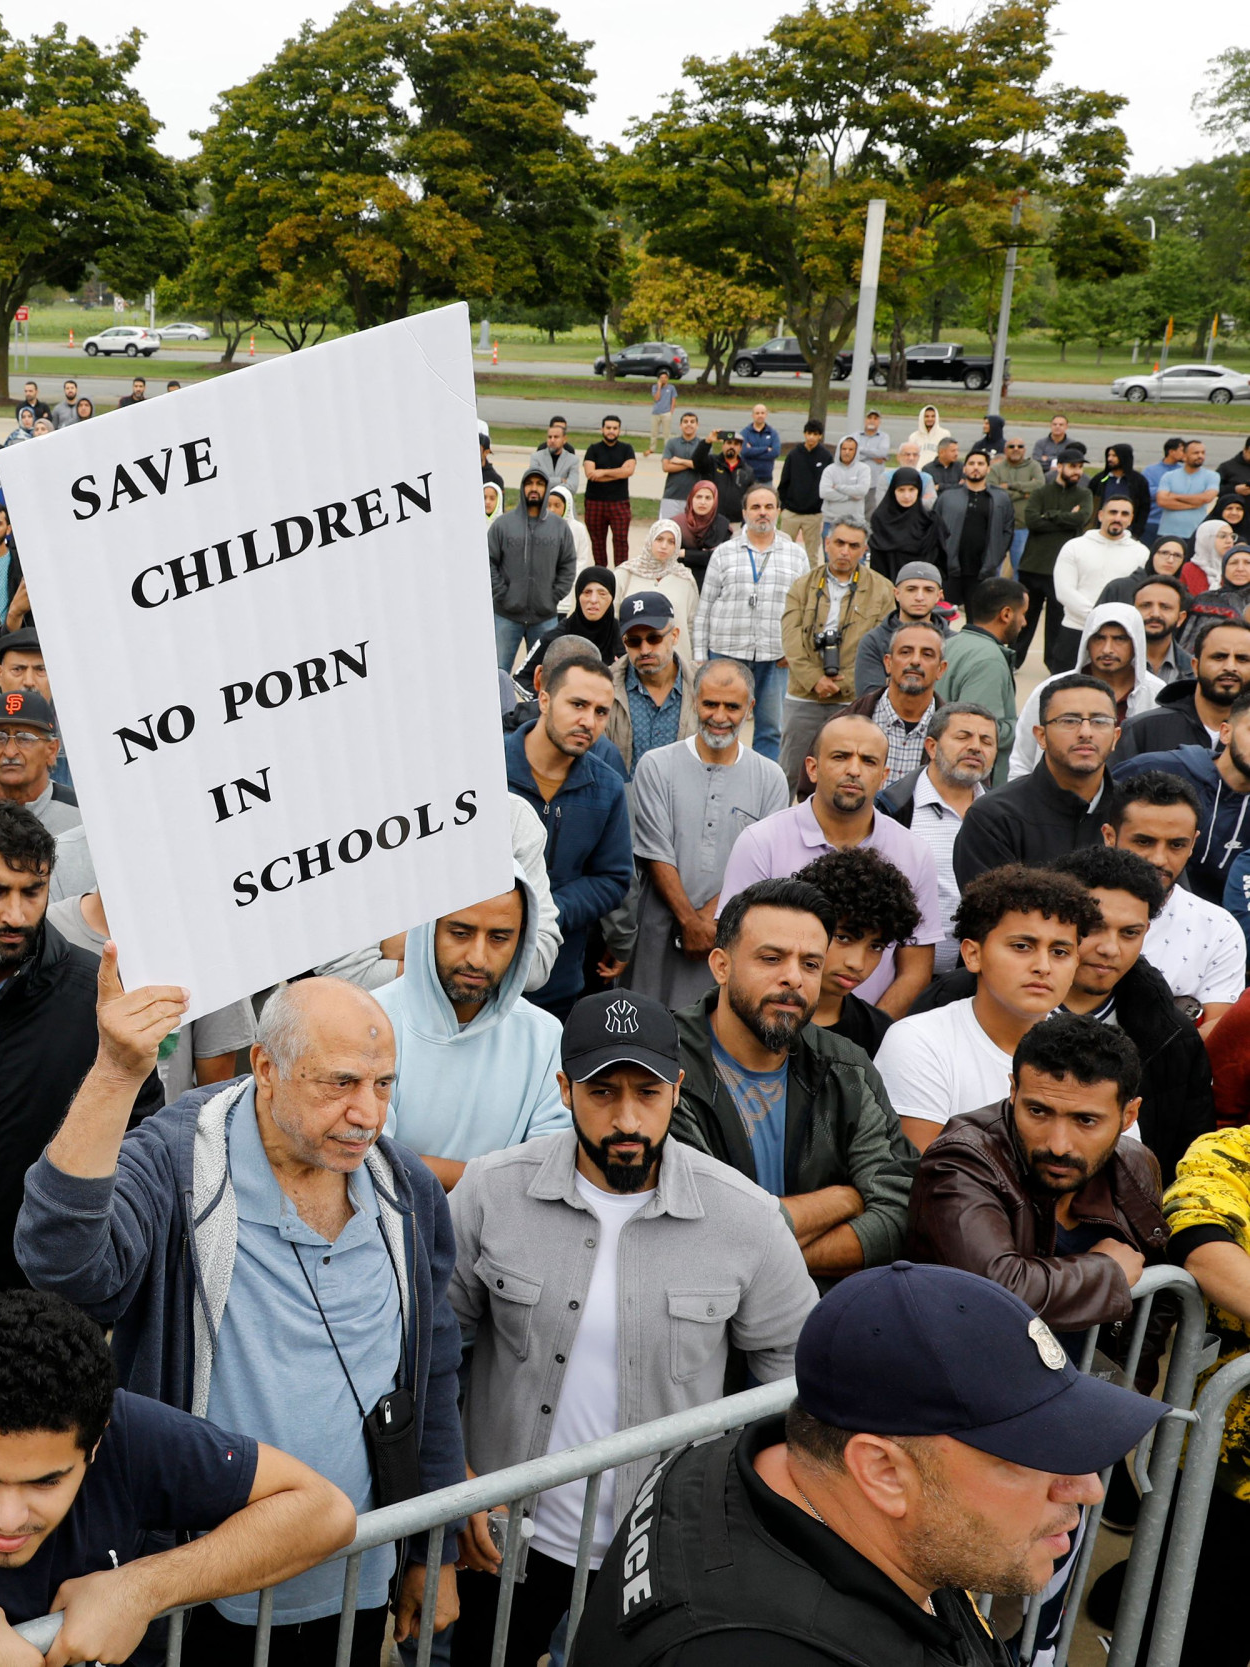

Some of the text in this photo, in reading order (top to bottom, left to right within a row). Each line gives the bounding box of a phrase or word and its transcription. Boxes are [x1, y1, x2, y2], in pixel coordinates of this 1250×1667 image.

[71, 437, 218, 521] SAVE
[131, 472, 432, 609] CHILDREN
[112, 640, 369, 766] NO PORN
[207, 766, 272, 824] IN
[233, 790, 477, 907] SCHOOLS
